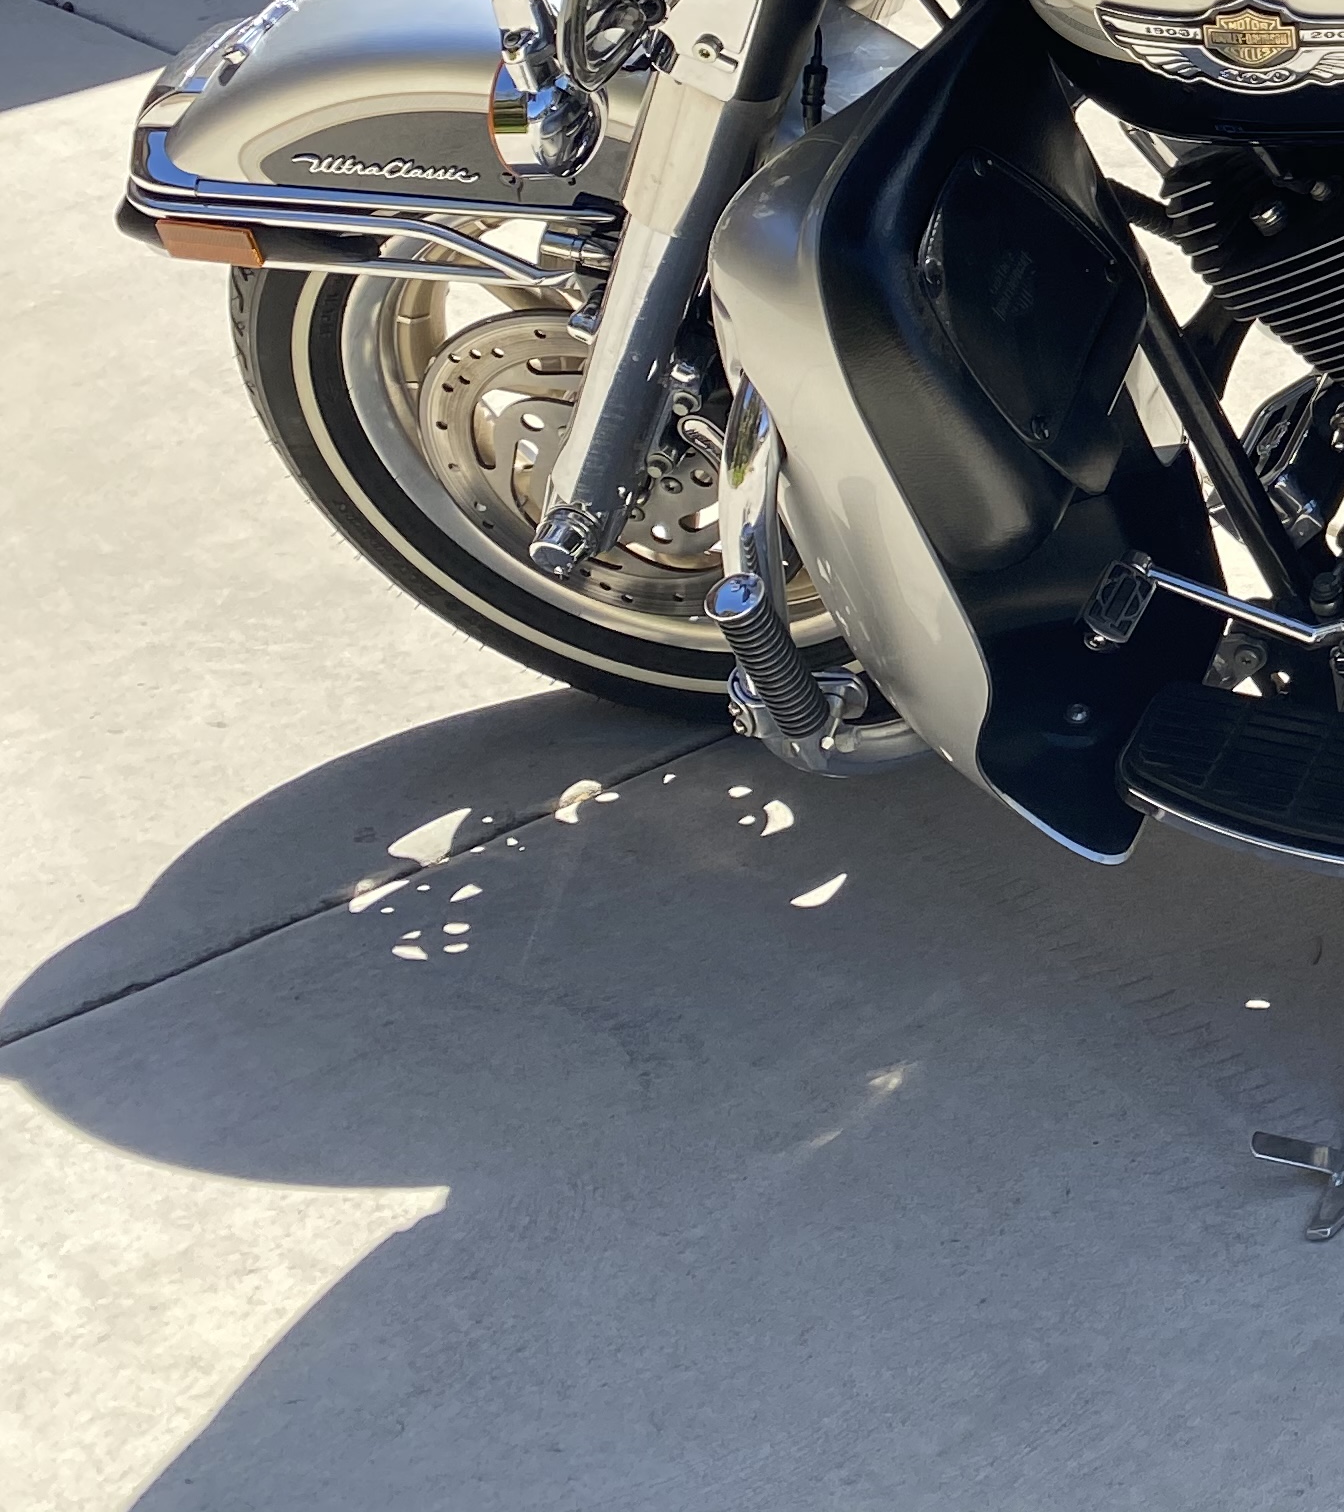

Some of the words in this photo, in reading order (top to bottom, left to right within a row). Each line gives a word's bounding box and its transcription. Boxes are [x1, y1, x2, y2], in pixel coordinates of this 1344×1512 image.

[1227, 17, 1269, 30] MOTOR
[1230, 47, 1271, 61] CYCLES
[383, 157, 480, 183] Classic
